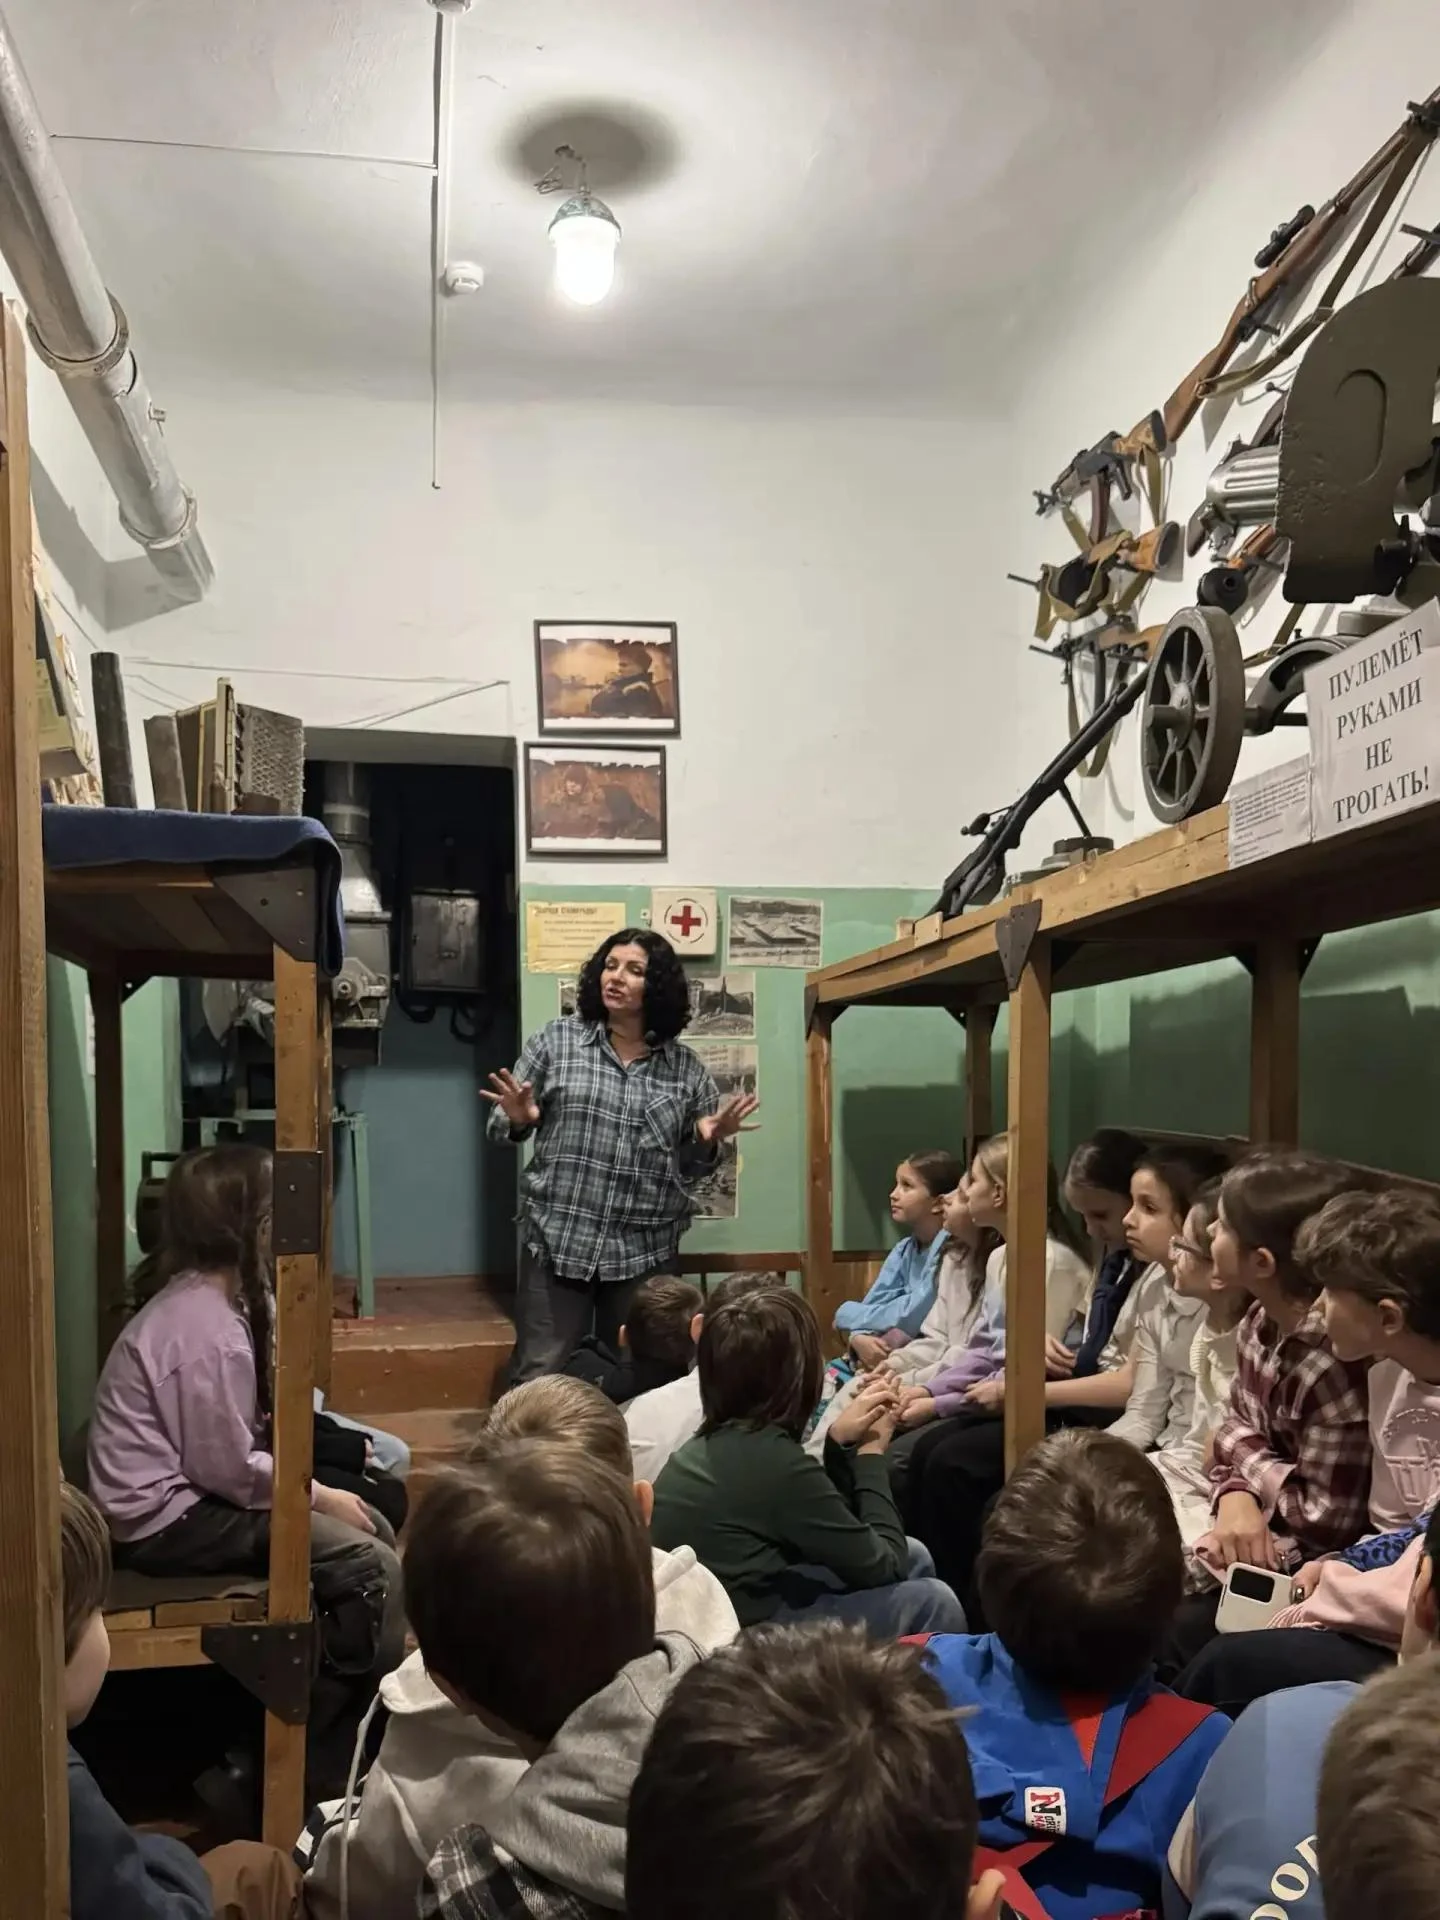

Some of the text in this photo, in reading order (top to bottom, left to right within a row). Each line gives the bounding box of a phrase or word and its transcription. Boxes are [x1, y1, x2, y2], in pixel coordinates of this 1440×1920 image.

[1329, 628, 1424, 700] ПУЛЕМЁТ
[1336, 677, 1423, 740] РУКАМИ
[1365, 738, 1393, 771] НЕ
[1333, 765, 1429, 824] ТРОГАТЬ!
